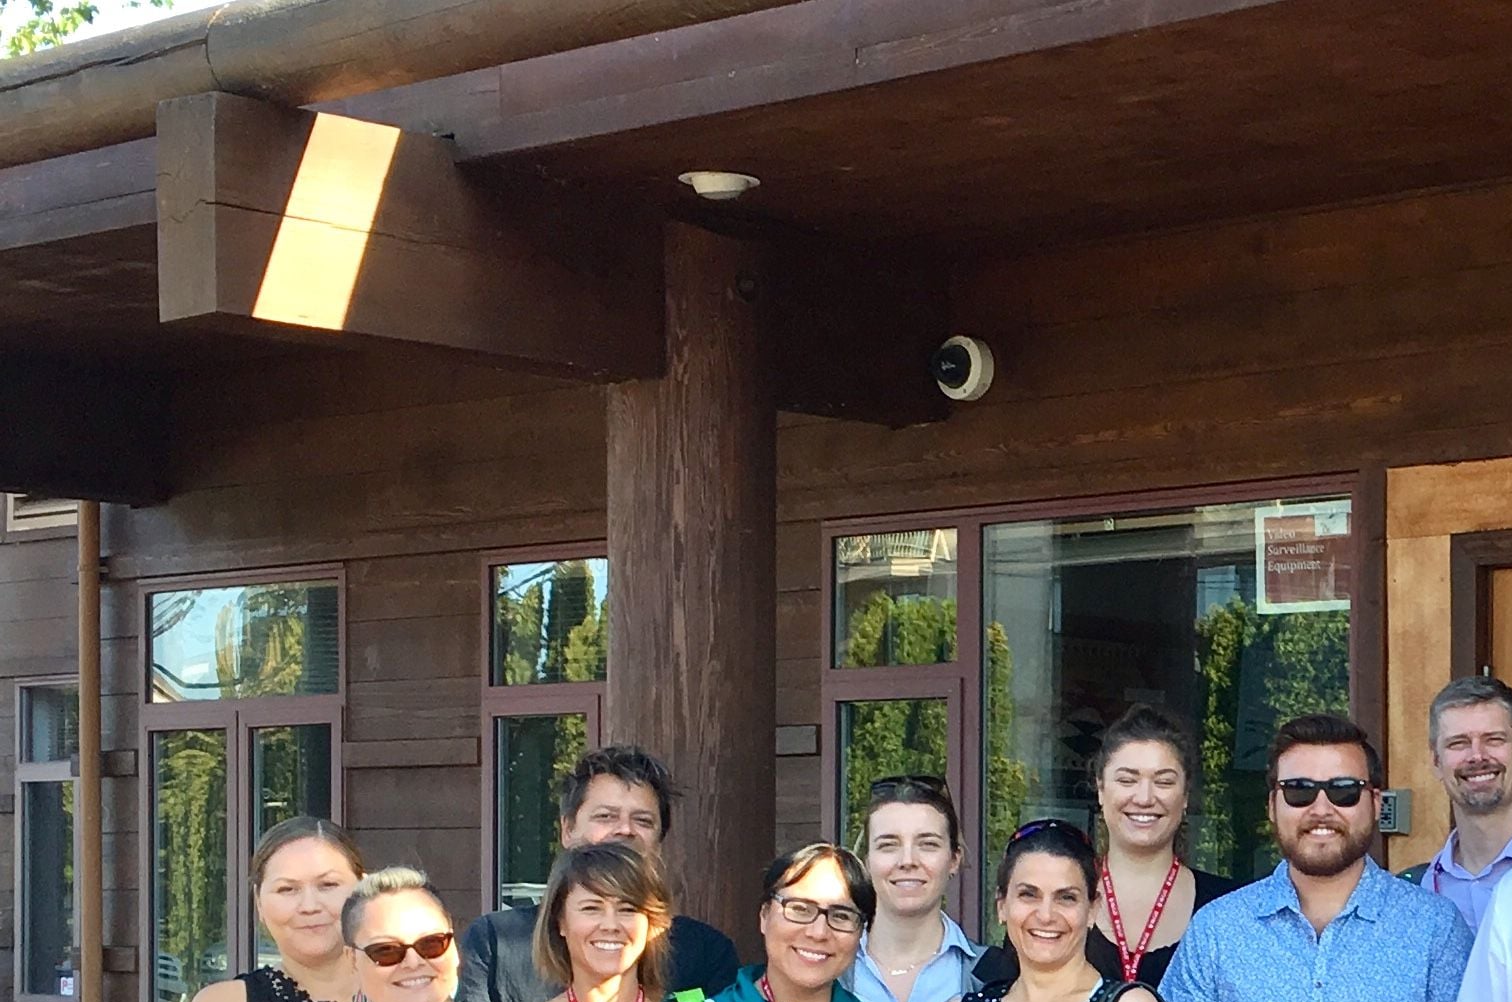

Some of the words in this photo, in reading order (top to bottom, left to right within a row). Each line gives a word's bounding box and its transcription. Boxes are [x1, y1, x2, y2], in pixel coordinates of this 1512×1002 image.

[1267, 527, 1296, 540] Video
[1267, 543, 1326, 556] Surveillance
[1267, 560, 1321, 574] Equipment
